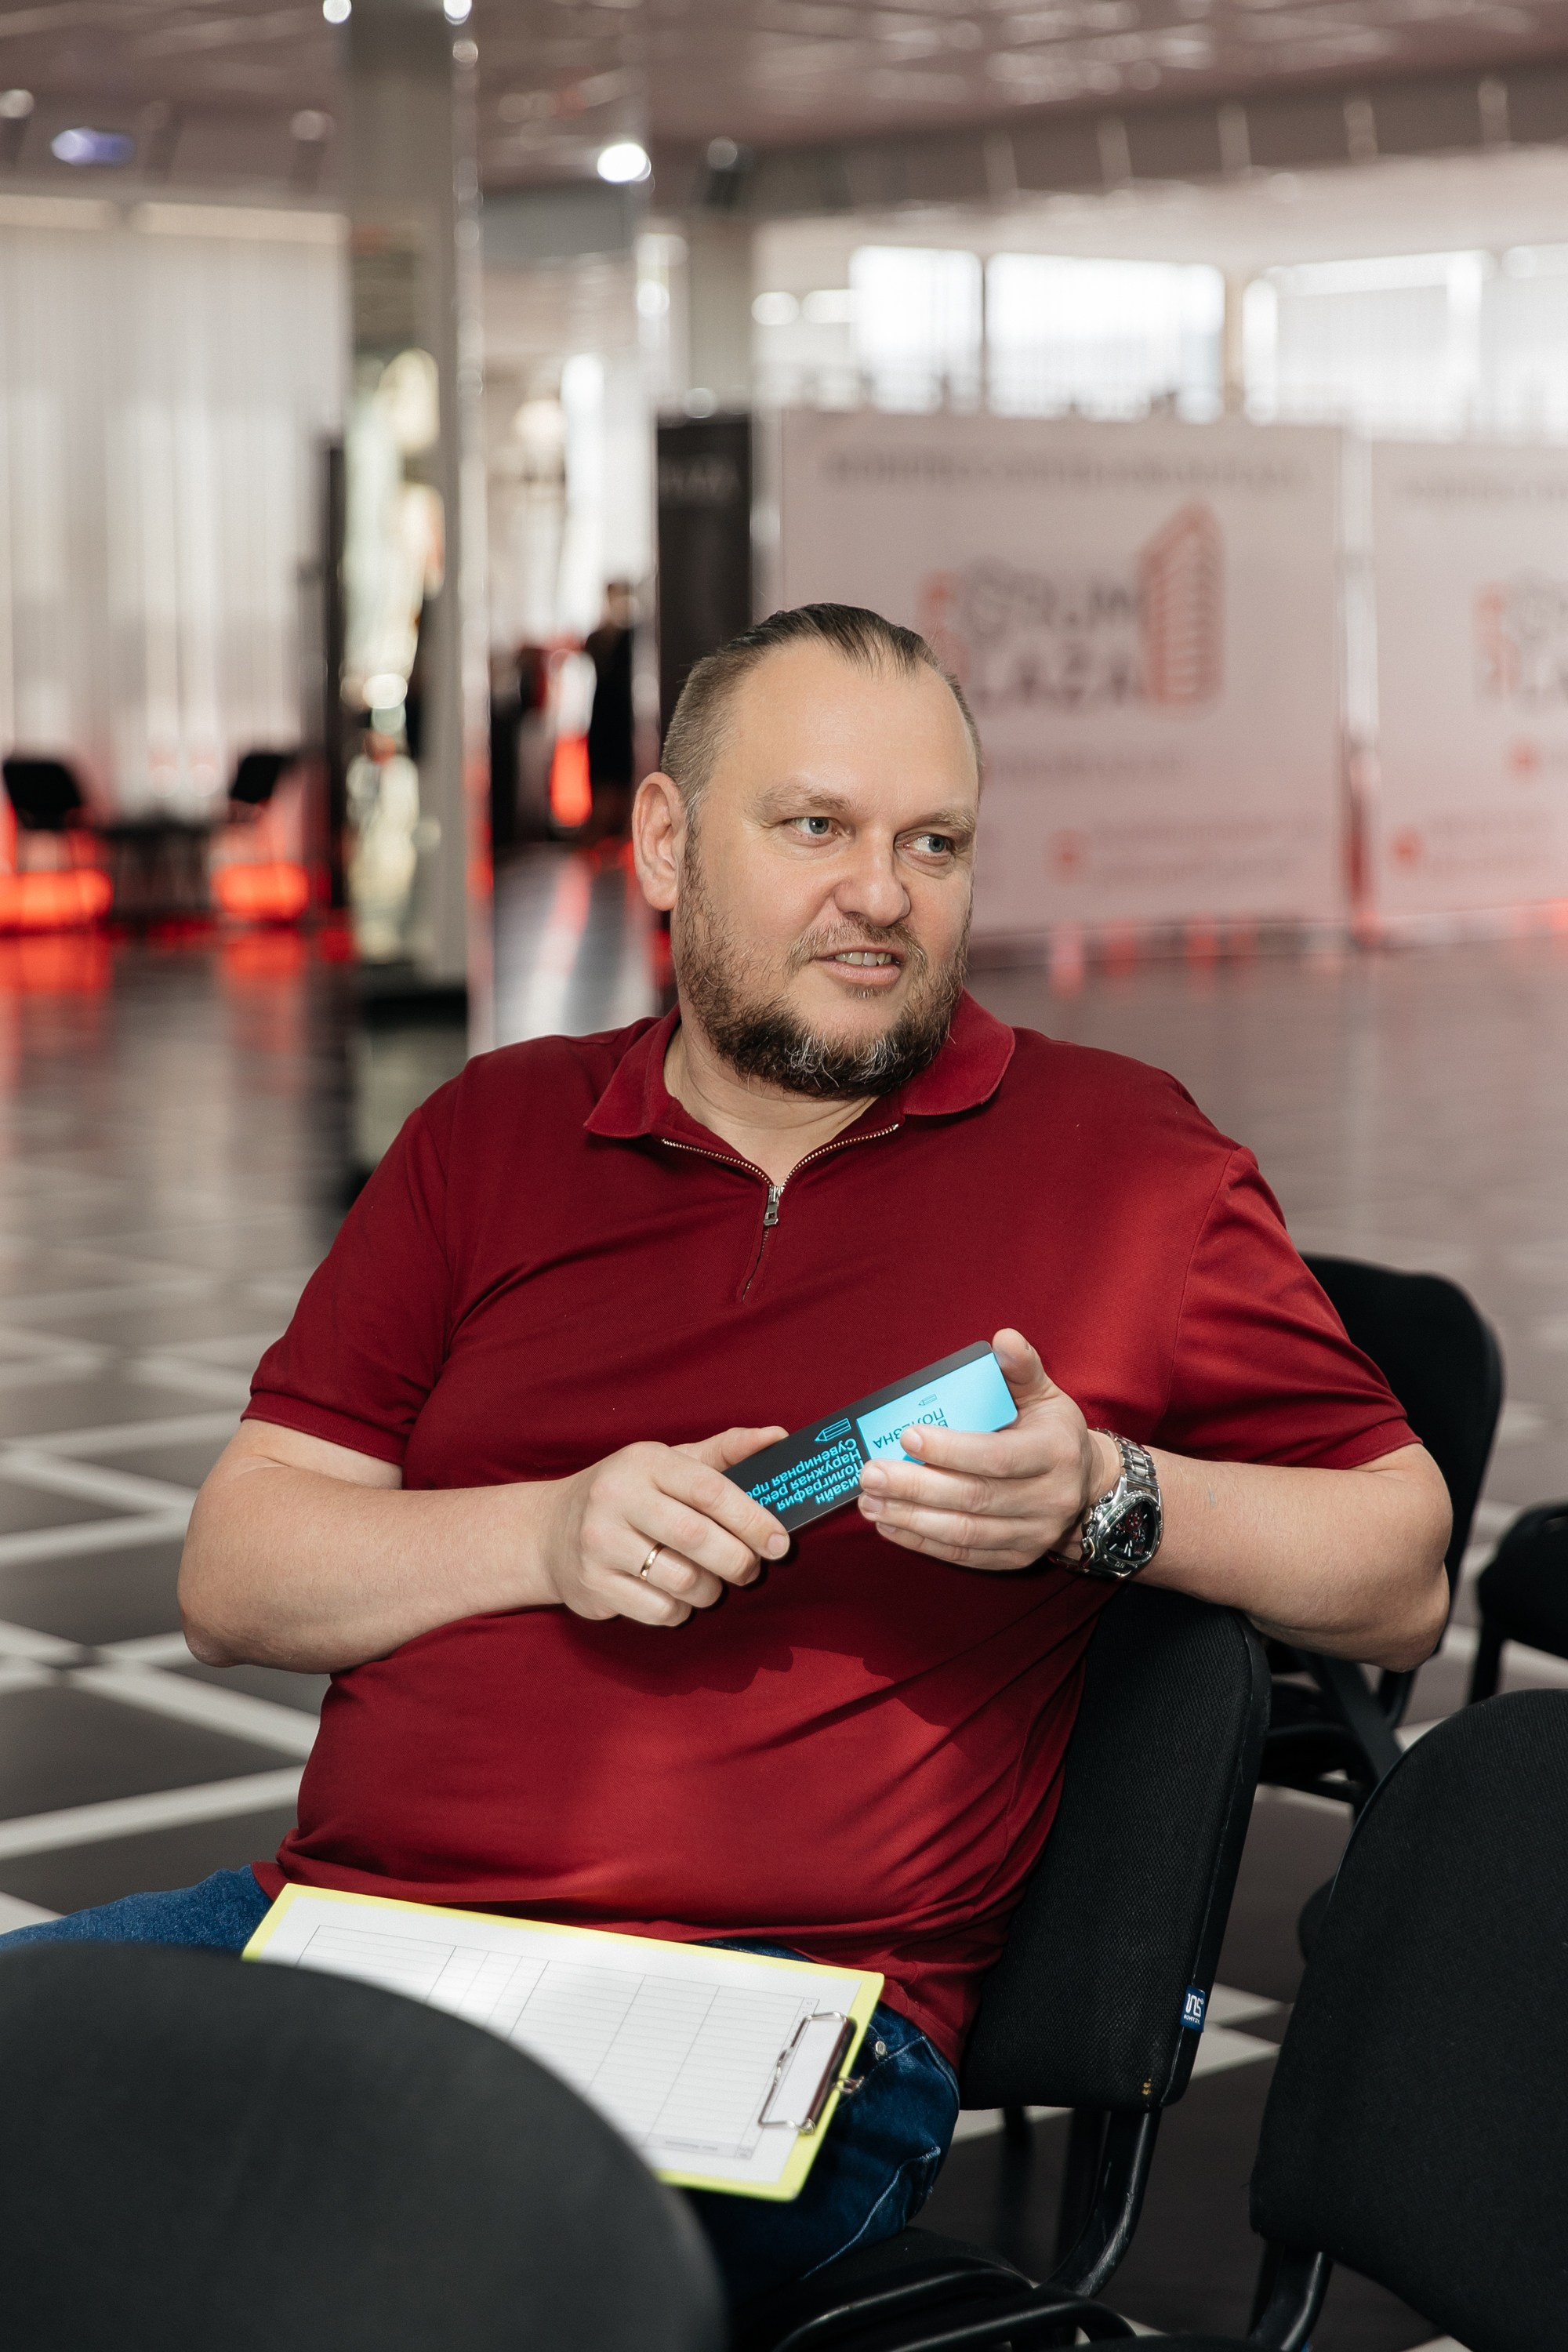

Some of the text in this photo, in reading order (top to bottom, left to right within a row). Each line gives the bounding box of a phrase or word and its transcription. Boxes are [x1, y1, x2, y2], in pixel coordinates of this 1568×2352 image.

[873, 1407, 944, 1449] ПОЗНА
[771, 1438, 857, 1486] Сувенирная
[789, 1449, 862, 1490] Наружная
[776, 1460, 864, 1512] Полиграфия
